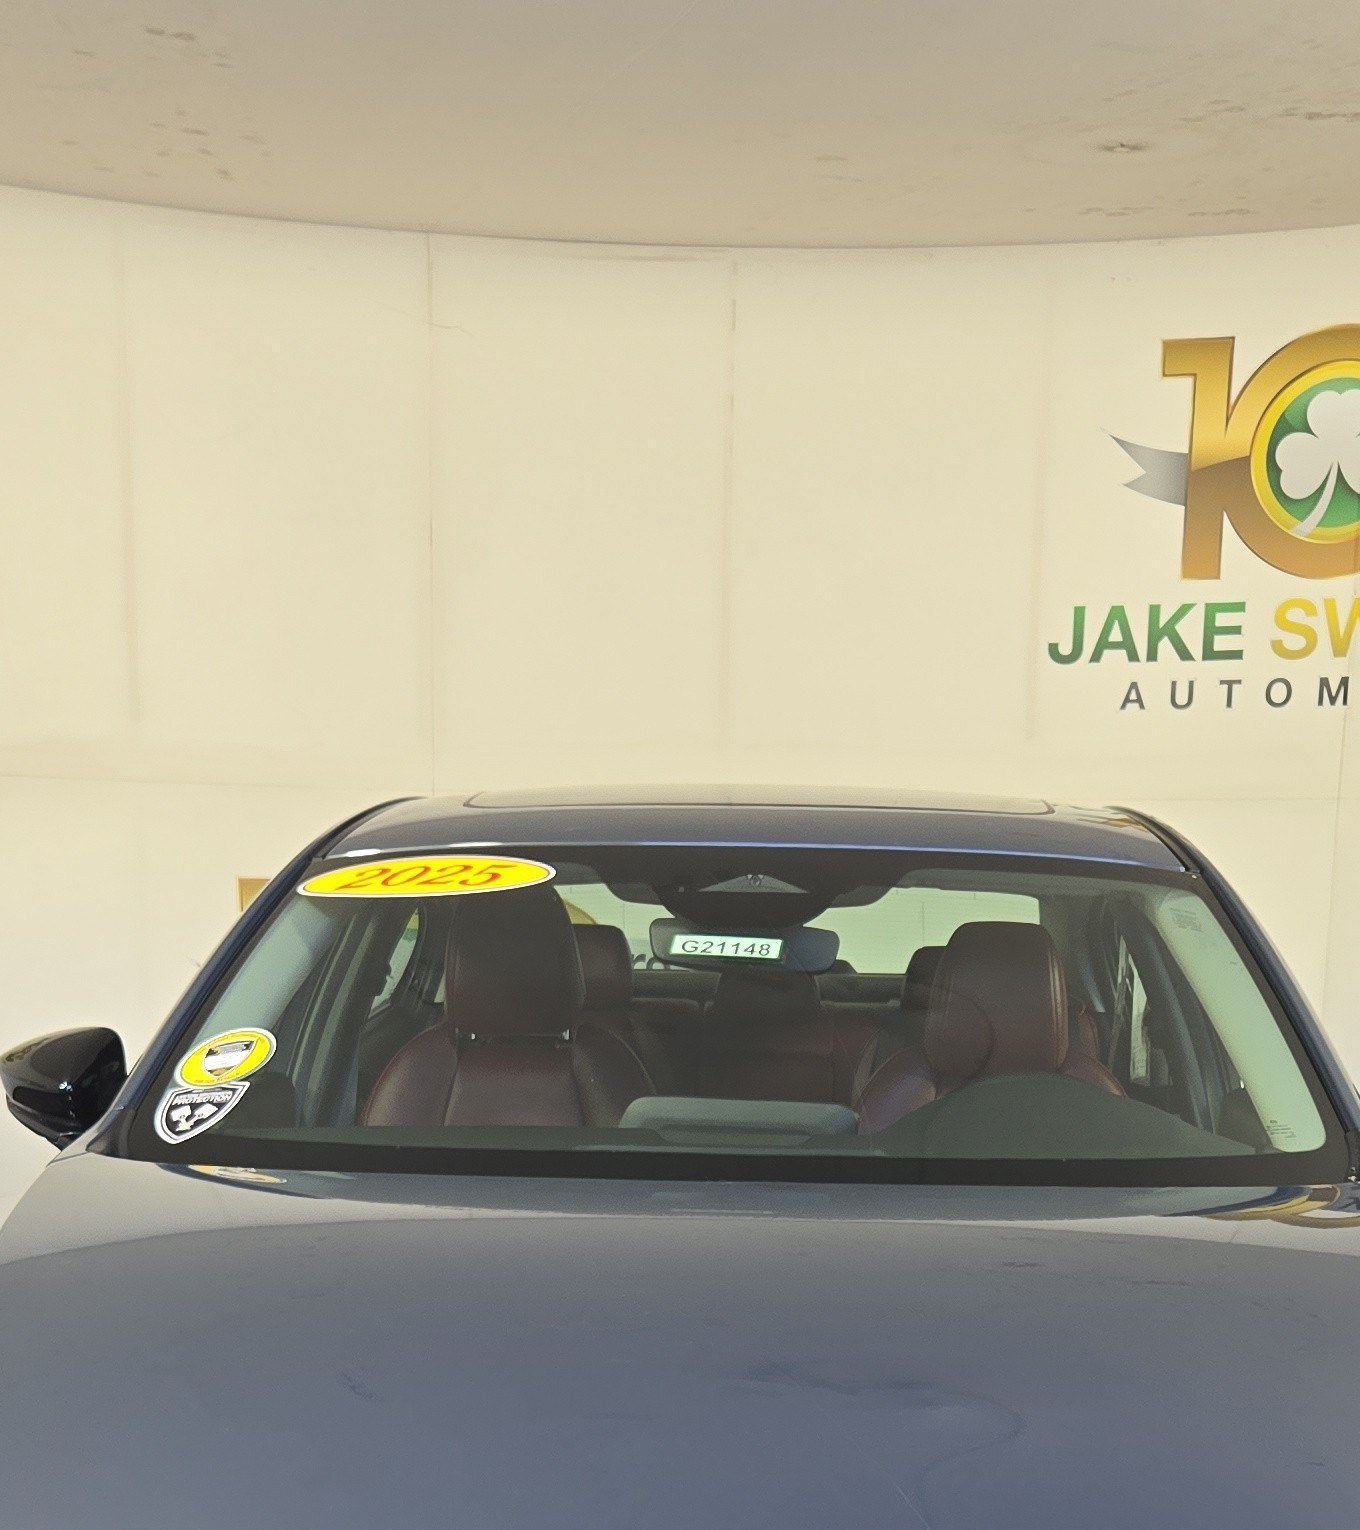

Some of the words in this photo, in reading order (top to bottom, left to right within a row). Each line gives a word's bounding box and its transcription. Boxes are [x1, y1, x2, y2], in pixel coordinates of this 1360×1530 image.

[1047, 601, 1247, 666] JAKE
[336, 864, 518, 890] 2025
[681, 940, 771, 957] G21148
